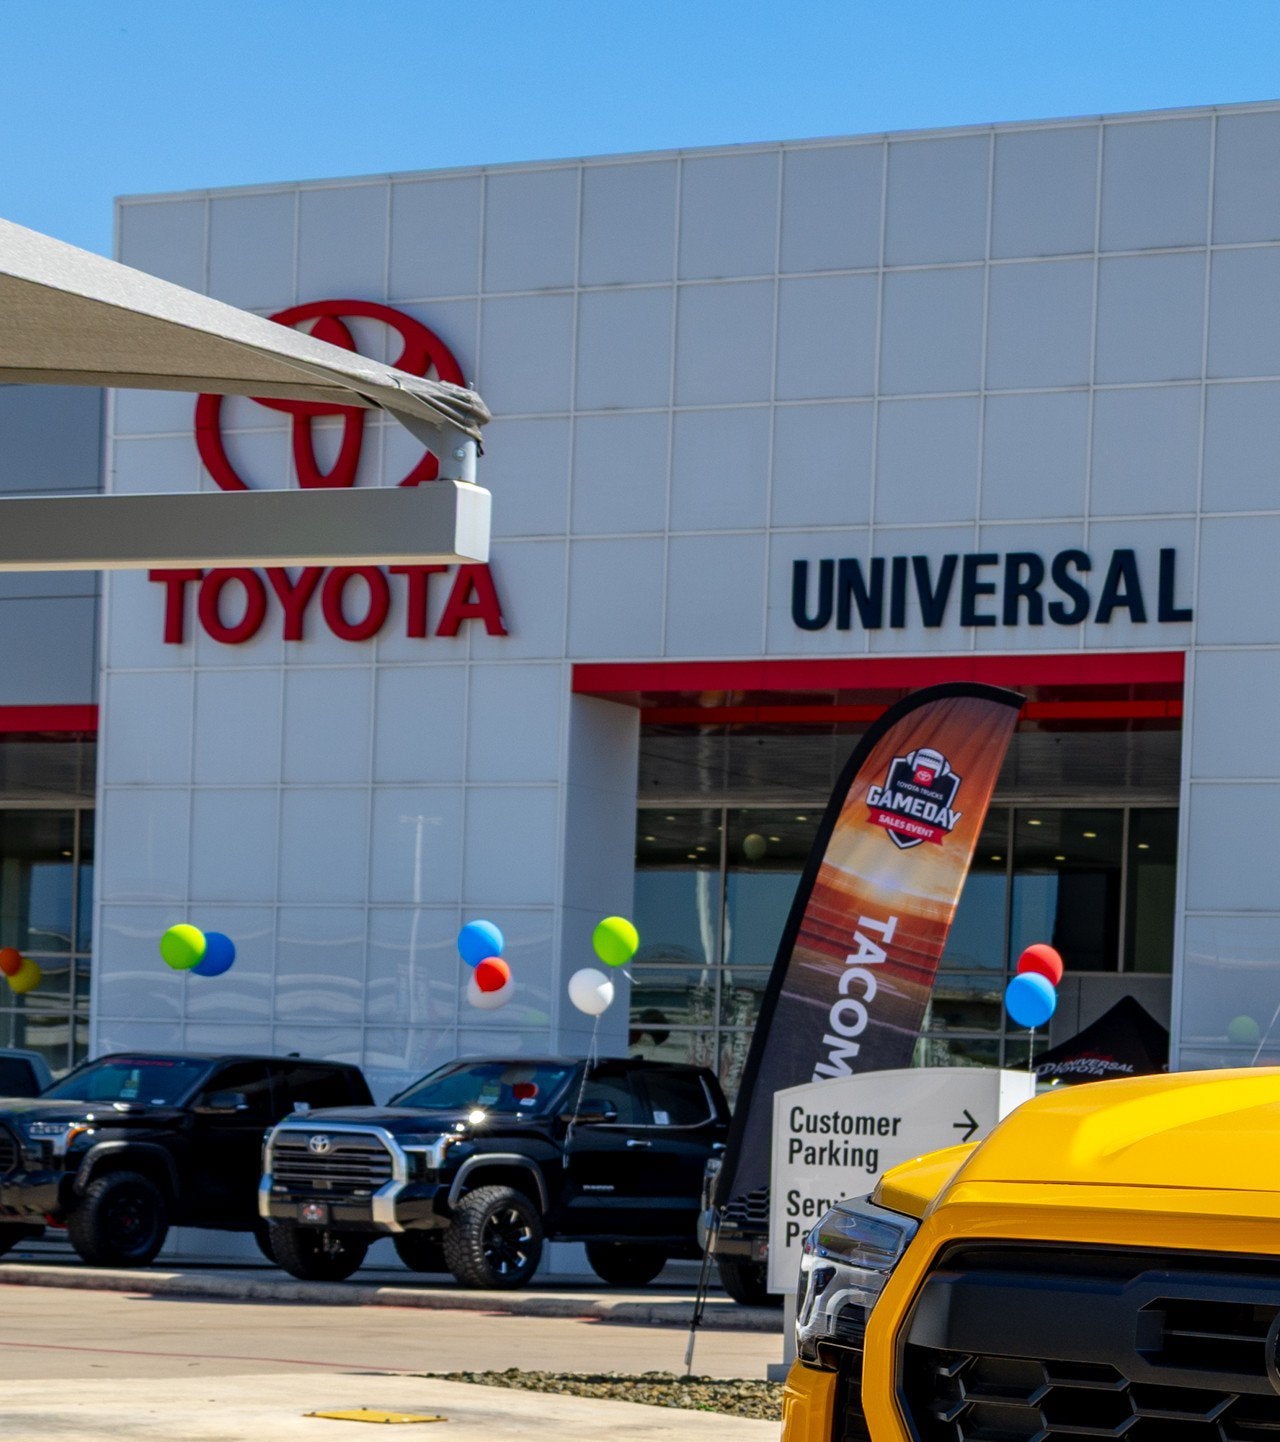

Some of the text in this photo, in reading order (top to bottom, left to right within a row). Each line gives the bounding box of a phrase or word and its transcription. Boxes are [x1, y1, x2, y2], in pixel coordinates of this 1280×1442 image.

[149, 563, 509, 645] TOYOTA
[791, 547, 1194, 632] UNIVERSAL
[866, 784, 963, 831] GAMEDAY
[920, 785, 944, 801] TRUCKS
[878, 814, 935, 838] SALES EVENT
[811, 915, 898, 1083] TACOM
[1055, 1064, 1104, 1075] TOYOTA
[1060, 1058, 1134, 1073] UNIVERSAL
[789, 1105, 902, 1137] Customer
[788, 1137, 879, 1174] Parking
